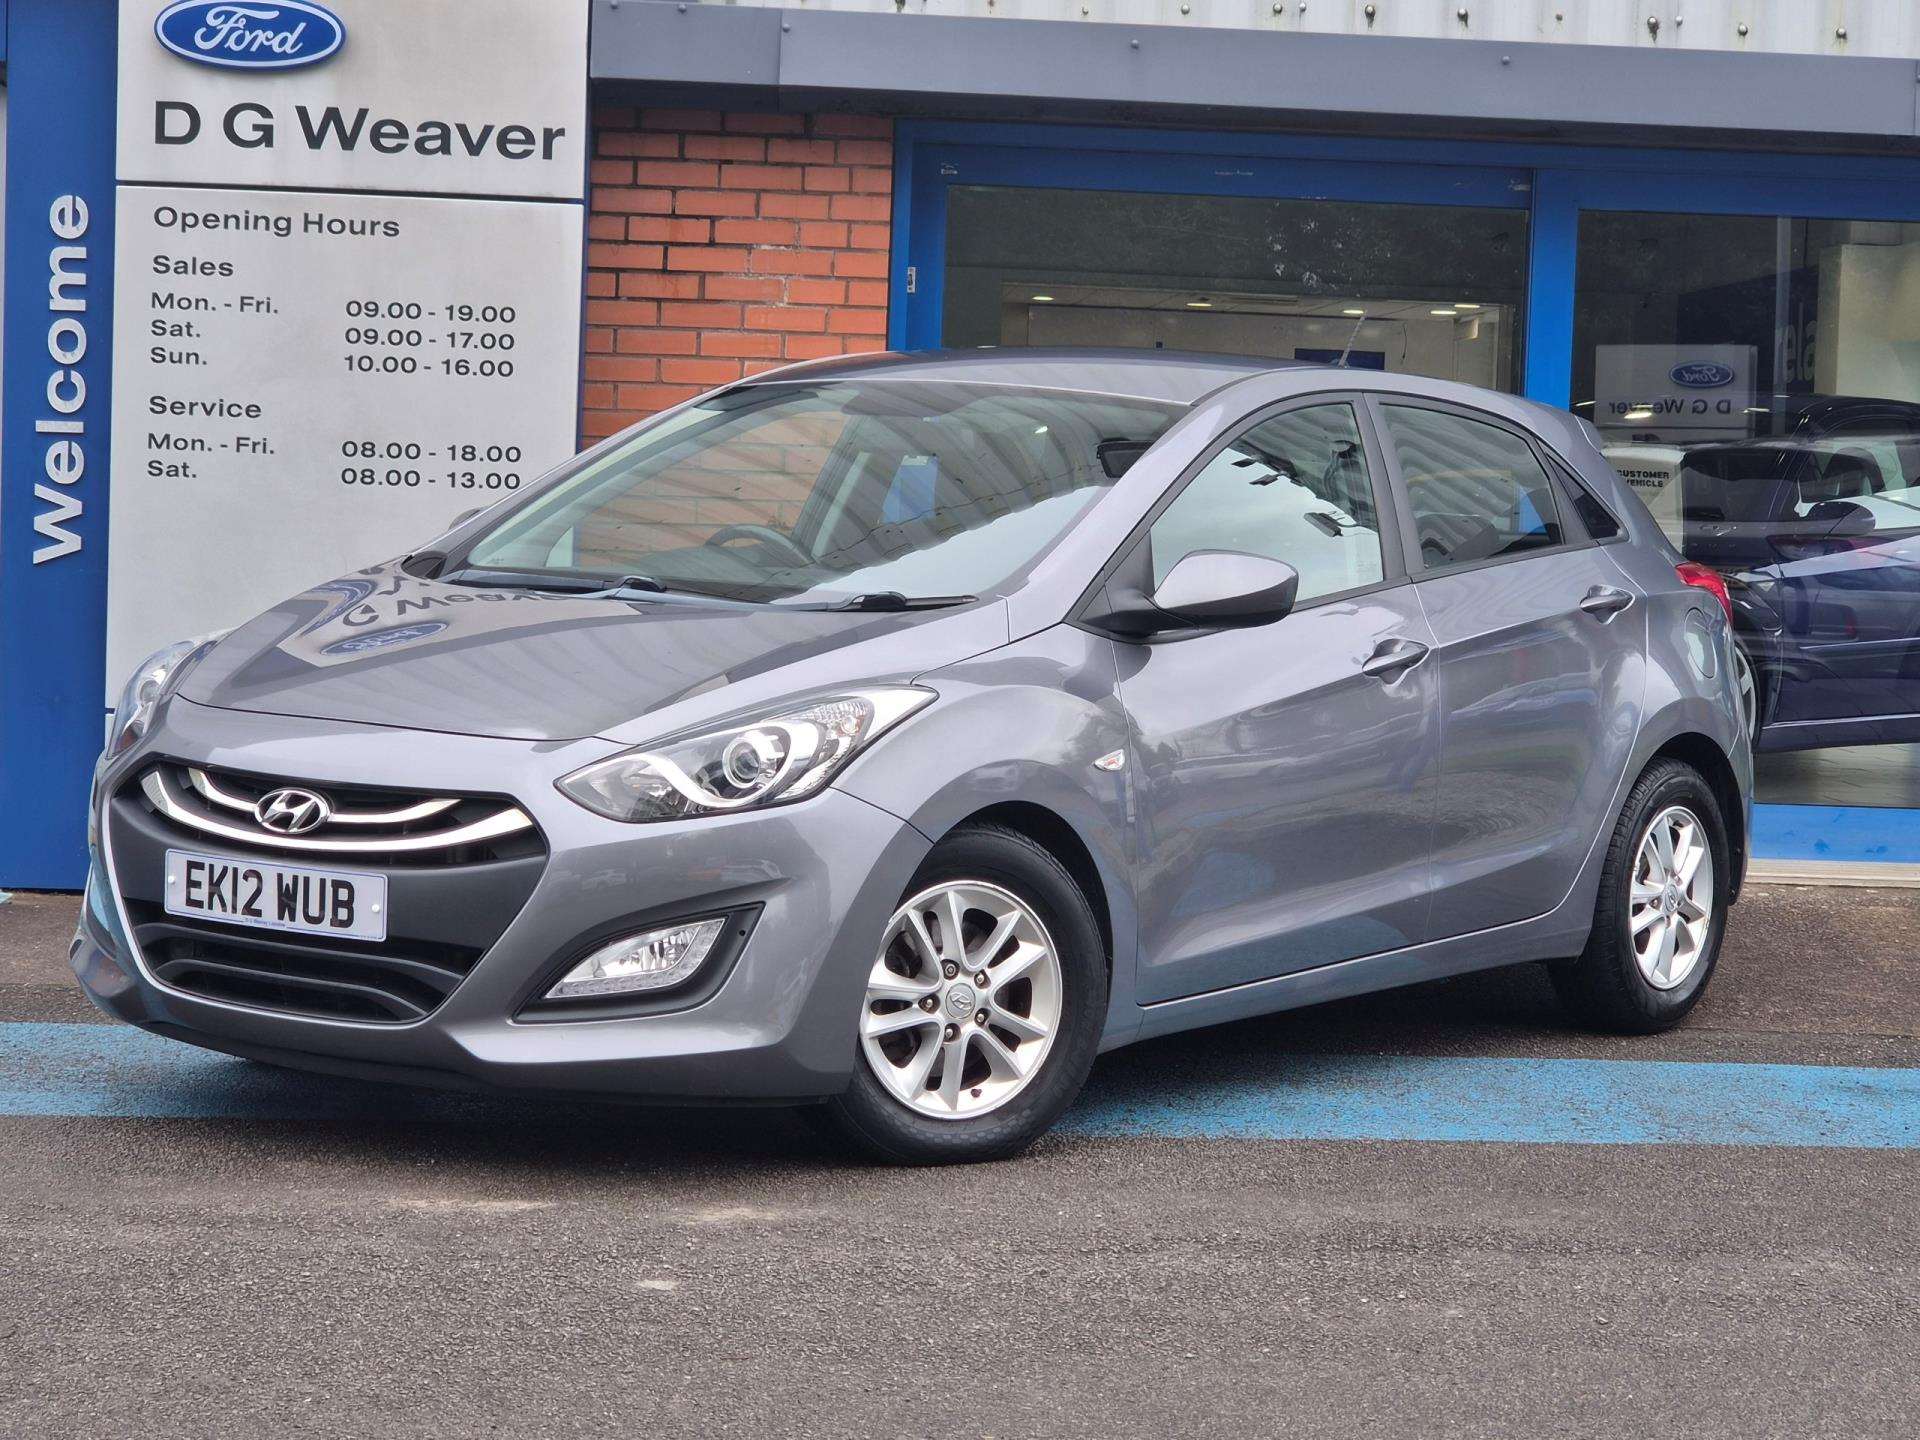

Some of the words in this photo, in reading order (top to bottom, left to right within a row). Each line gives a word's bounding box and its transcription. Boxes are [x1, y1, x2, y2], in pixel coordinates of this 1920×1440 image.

[194, 5, 307, 54] Ford
[154, 100, 201, 145] D
[222, 102, 274, 149] G
[294, 105, 566, 161] Weaver
[153, 206, 292, 238] Opening
[303, 212, 400, 238] Hours
[152, 254, 234, 277] Sales
[151, 291, 216, 311] Mon.
[239, 295, 279, 314] Fri.
[345, 300, 422, 320] 09.00
[445, 304, 516, 324] 19.00
[151, 319, 201, 338] Sat.
[344, 327, 422, 347] 09.00
[446, 331, 515, 351] 17.00
[150, 346, 207, 366] Sun.
[344, 354, 417, 374] 10.00
[441, 358, 514, 378] 16.00
[32, 194, 89, 565] Welcome
[149, 395, 262, 419] Service
[147, 432, 213, 452] Mon.
[235, 436, 275, 455] Fri.
[341, 440, 421, 460] 08.00
[446, 444, 522, 463] 18.00
[147, 459, 197, 479] Sat.
[341, 467, 421, 487] 08.00
[446, 471, 521, 490] 13.00
[184, 859, 264, 918] EK12
[276, 872, 356, 929] WUB
